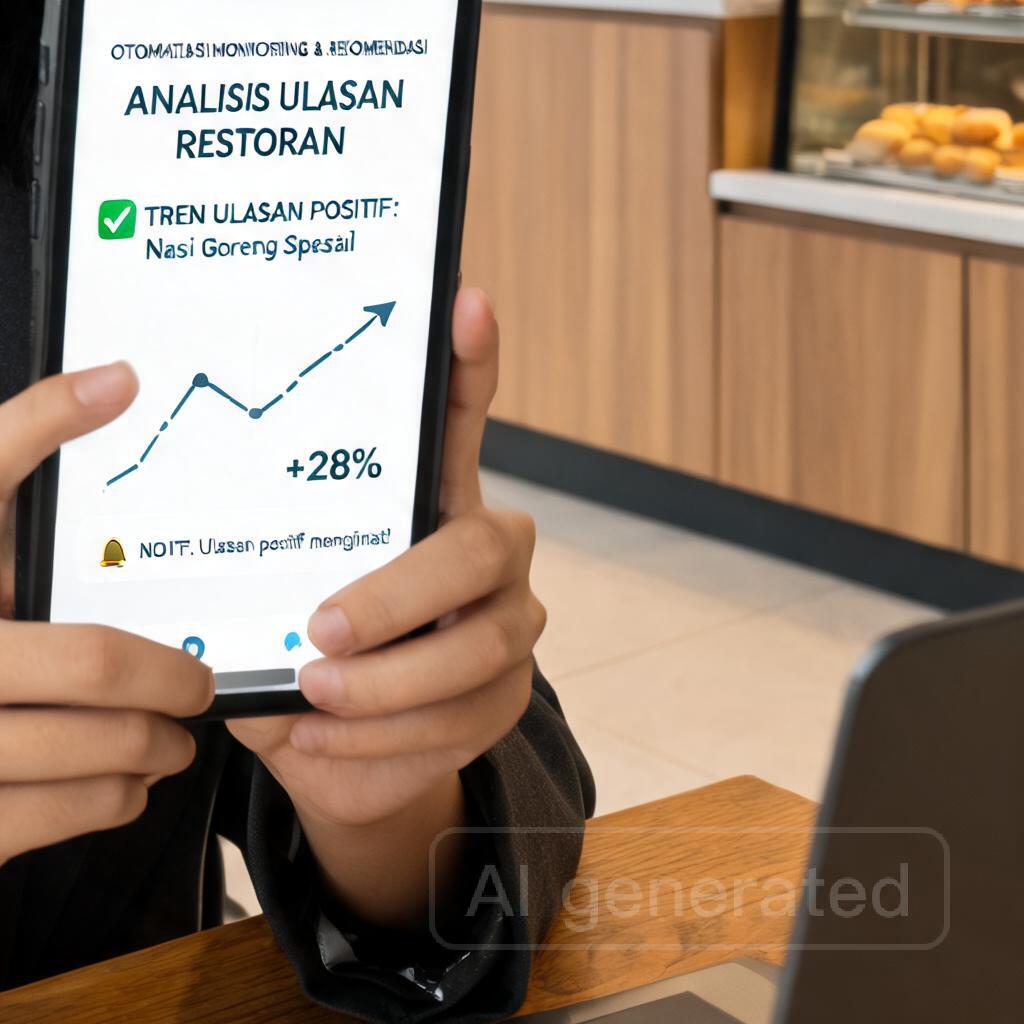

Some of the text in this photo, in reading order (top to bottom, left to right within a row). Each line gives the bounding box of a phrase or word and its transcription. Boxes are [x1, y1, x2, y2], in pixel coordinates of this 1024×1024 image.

[124, 79, 405, 116] ANALISIS ULASAN
[176, 126, 346, 159] RESTORAN
[144, 205, 206, 227] TREN
[213, 201, 304, 224] ULASAN
[146, 236, 195, 260] Nasi
[201, 238, 278, 262] Goreng
[286, 447, 383, 482] +28%
